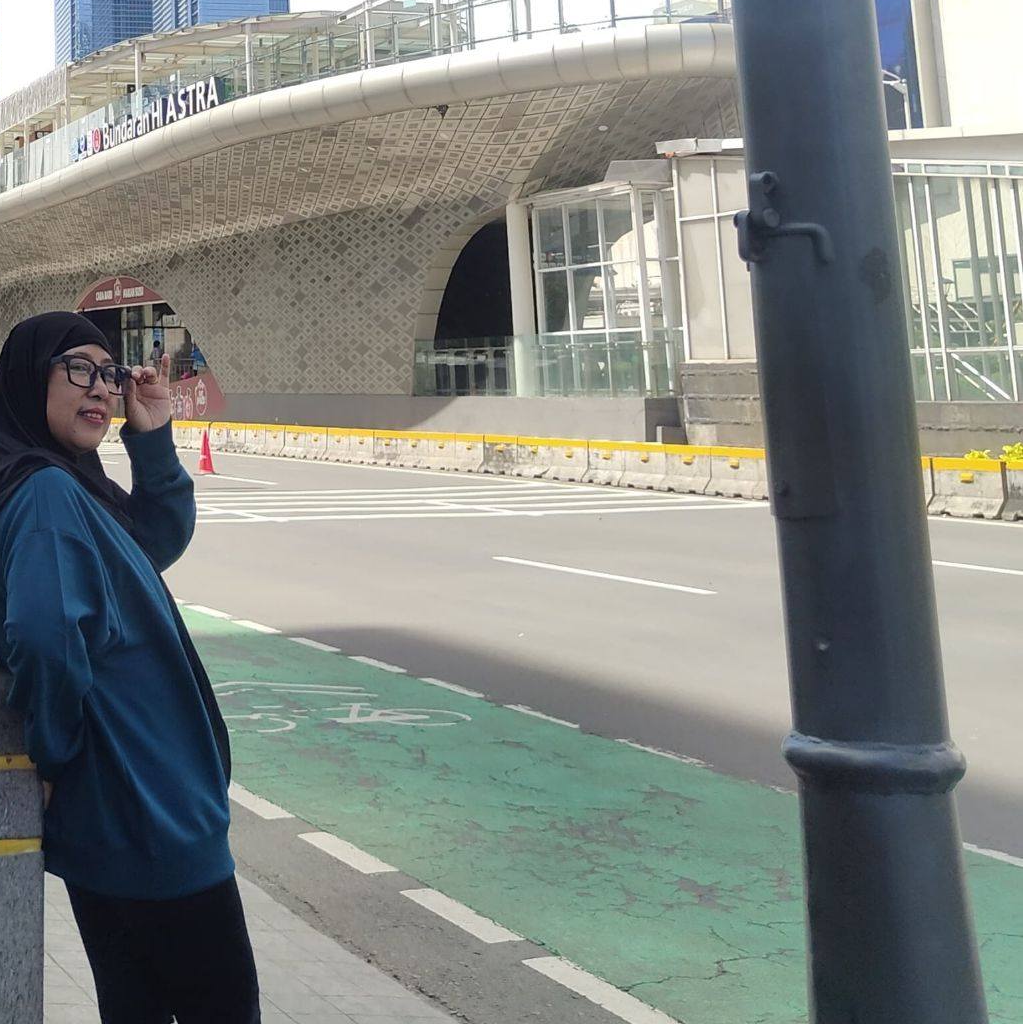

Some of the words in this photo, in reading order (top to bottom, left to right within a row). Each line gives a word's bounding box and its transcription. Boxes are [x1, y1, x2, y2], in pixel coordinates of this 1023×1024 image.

[103, 112, 150, 150] Bundaran
[151, 97, 163, 130] HI
[166, 76, 219, 124] ASTRA
